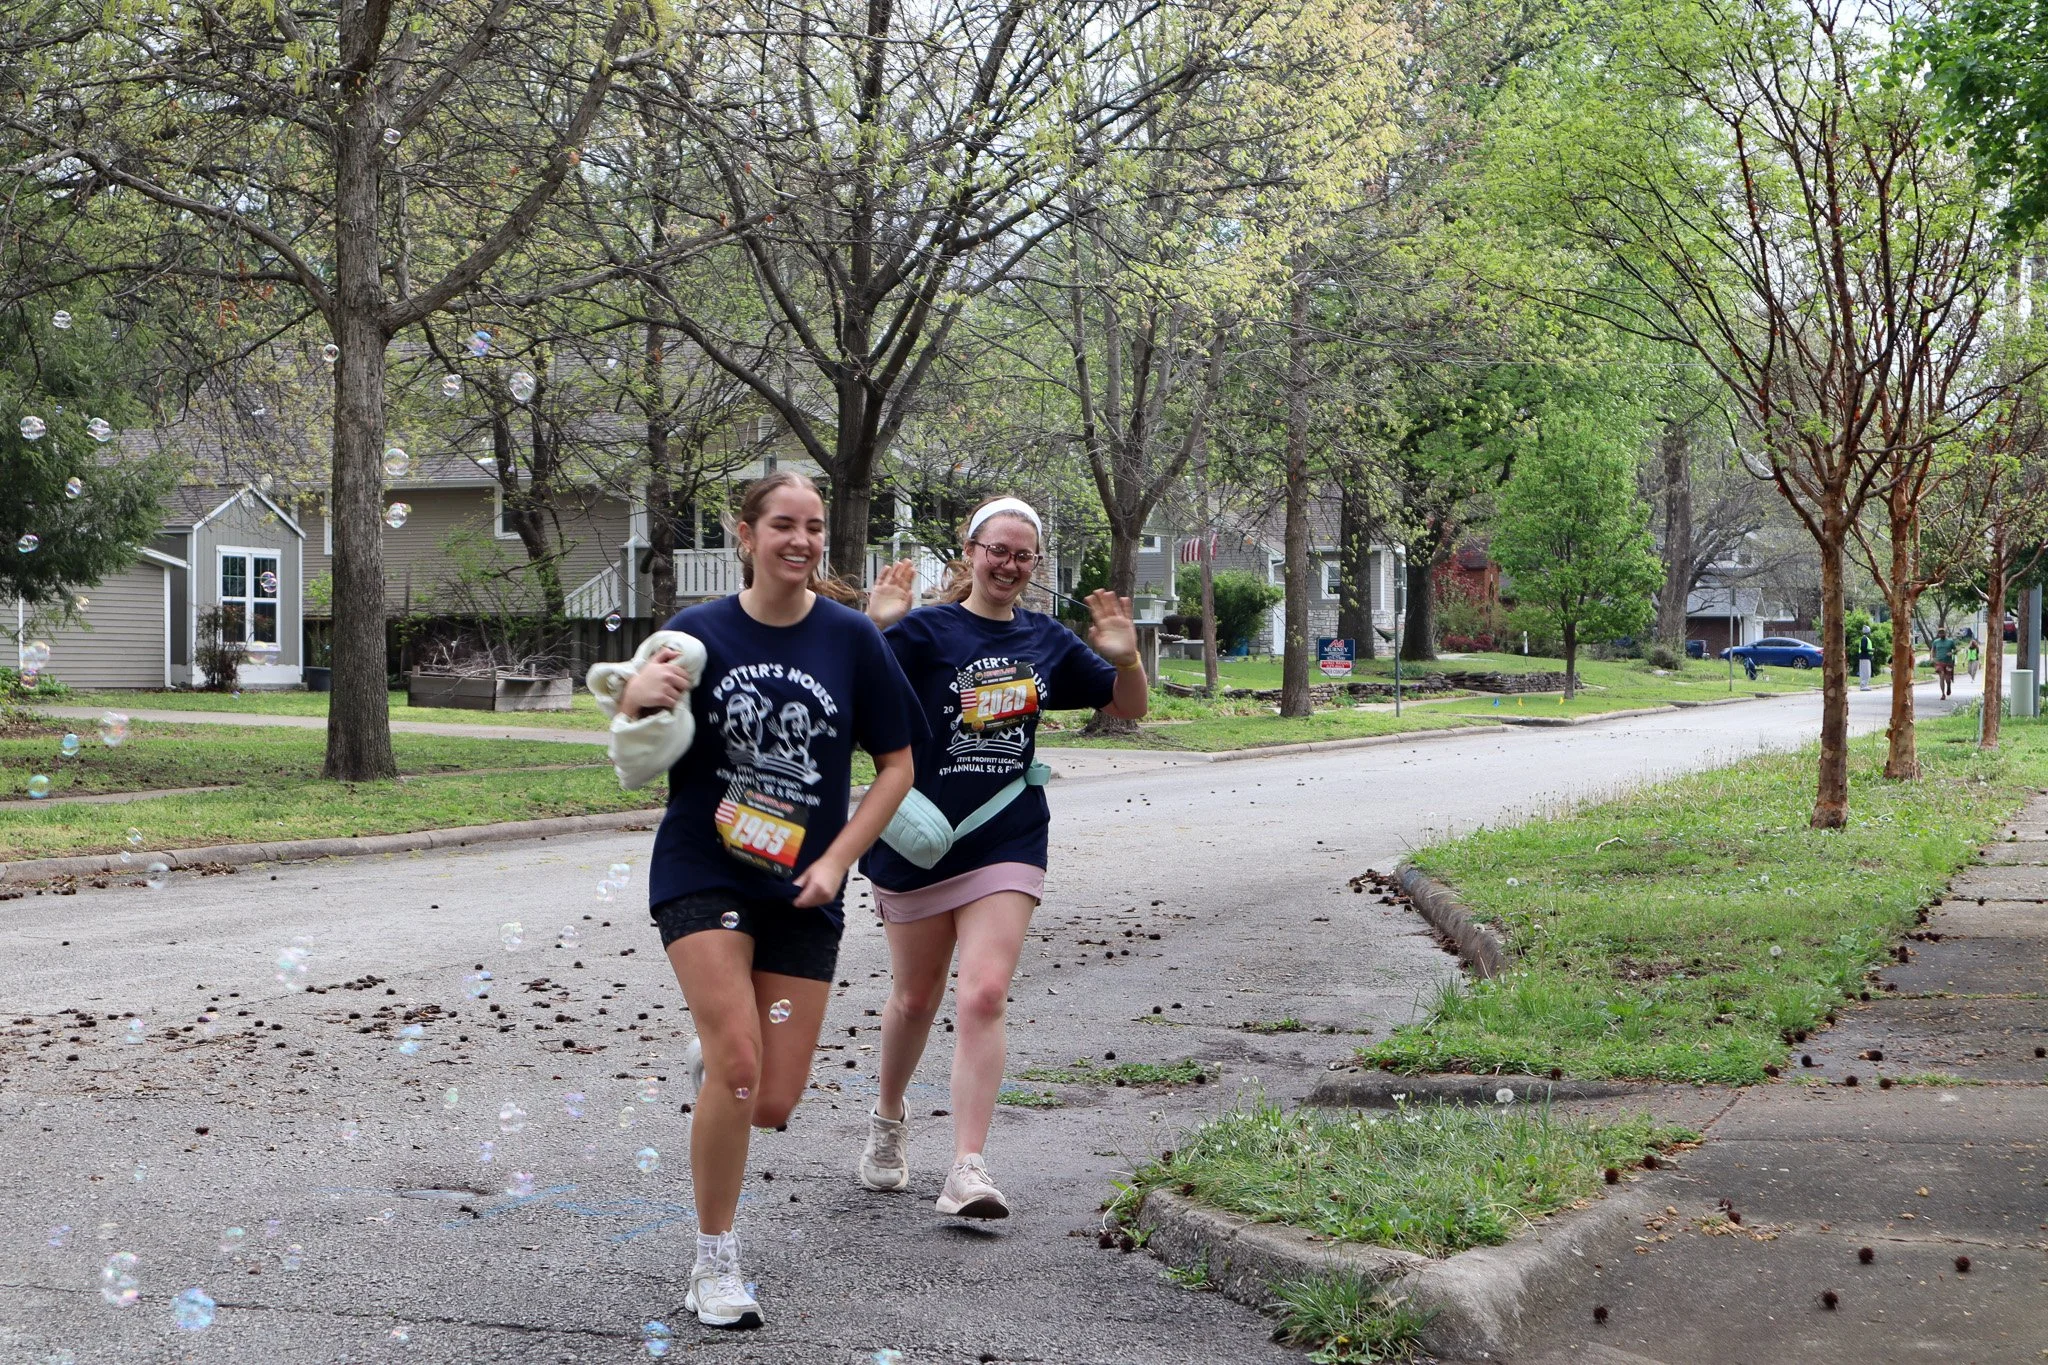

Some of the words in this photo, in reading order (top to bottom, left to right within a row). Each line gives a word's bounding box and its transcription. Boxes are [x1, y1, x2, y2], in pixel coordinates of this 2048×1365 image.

[713, 663, 784, 701] POTTER'S
[787, 667, 838, 717] HOUSE
[949, 657, 1009, 694] PTTER'S
[943, 705, 955, 714] 20
[977, 685, 1028, 718] 2020
[939, 766, 952, 776] 4TH
[952, 764, 985, 773] ANNUAL
[986, 765, 996, 773] 5K
[997, 766, 1004, 774] &
[998, 757, 1017, 765] LEGAC
[730, 811, 792, 855] 1965
